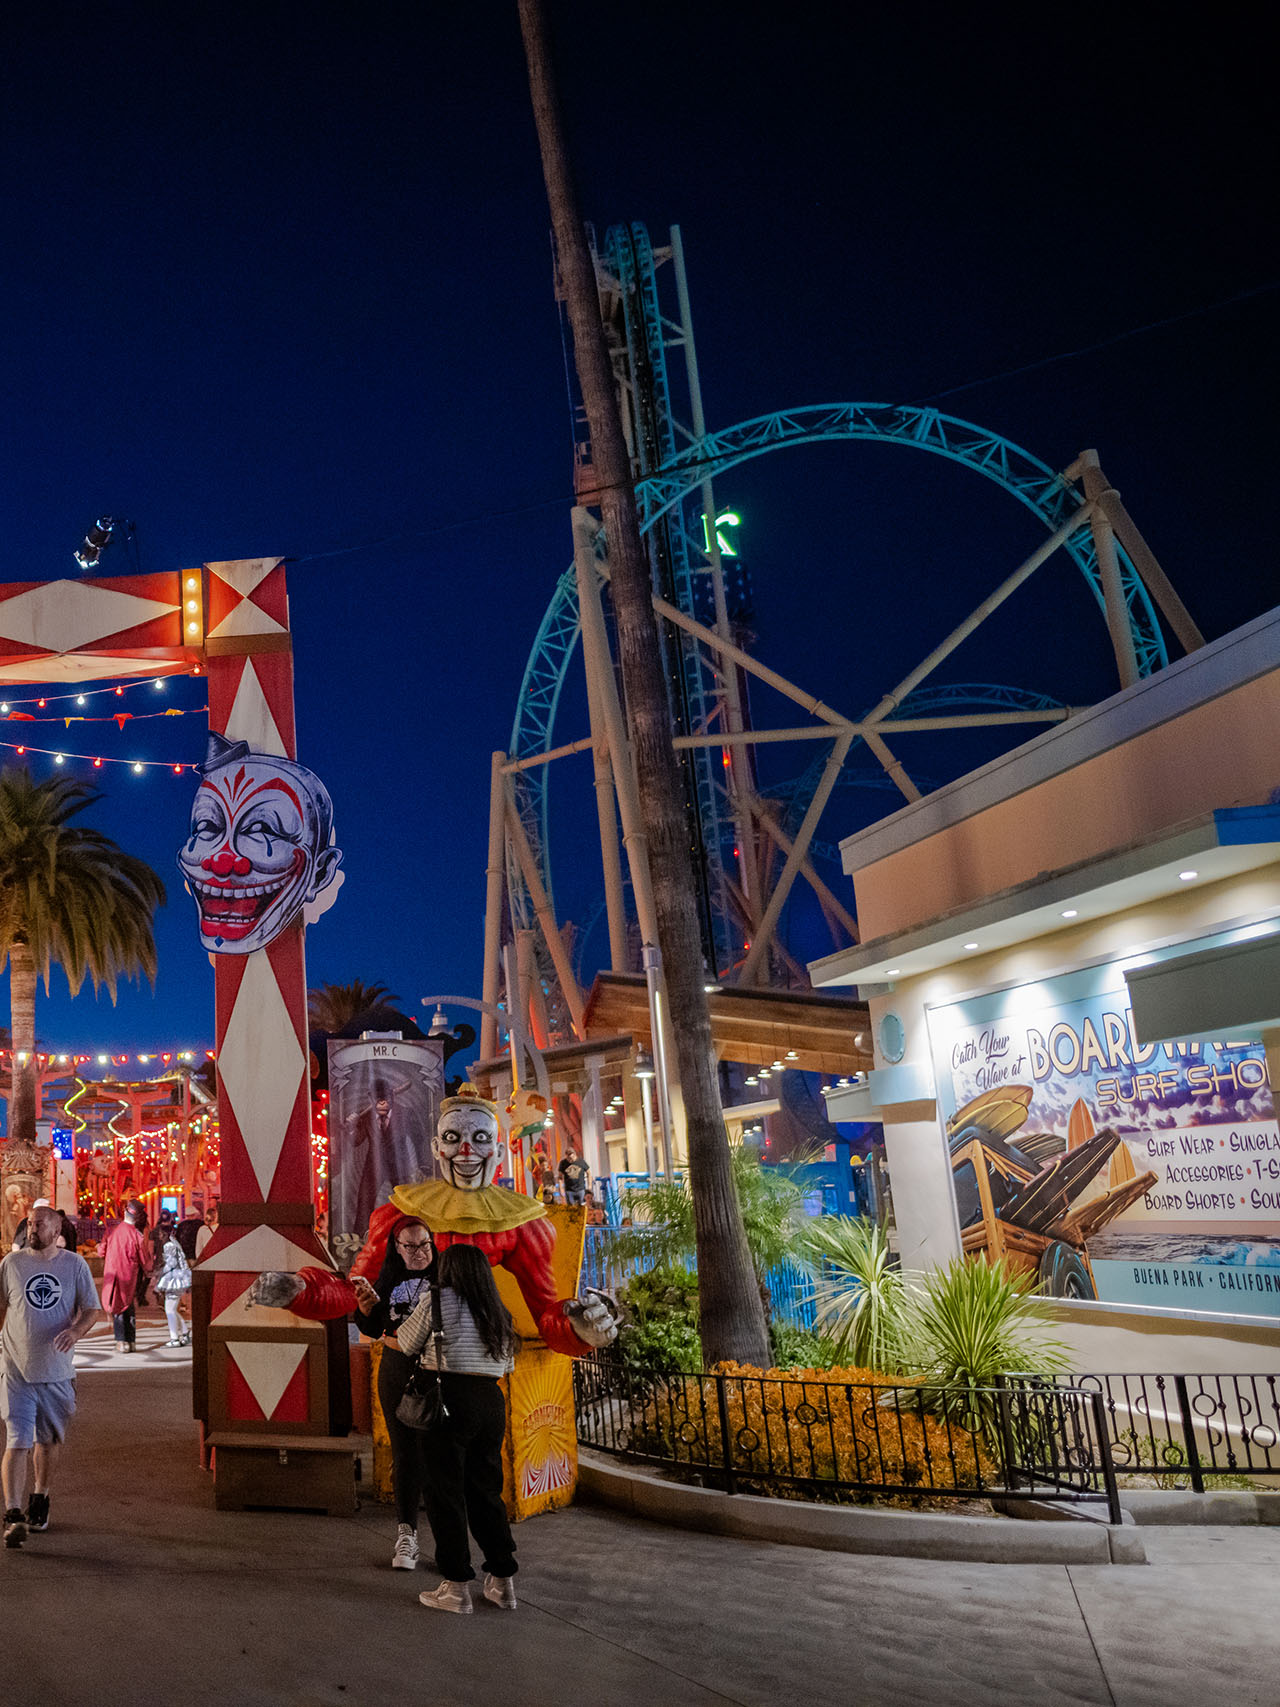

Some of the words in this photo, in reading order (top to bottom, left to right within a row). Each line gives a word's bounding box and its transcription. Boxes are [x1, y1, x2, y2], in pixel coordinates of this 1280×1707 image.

[373, 1046, 390, 1056] MR.
[392, 1046, 398, 1056] C
[952, 1039, 977, 1069] Catch
[979, 1029, 1010, 1063] Your
[976, 1062, 1008, 1090] Wave
[1012, 1054, 1026, 1075] at
[1096, 1069, 1178, 1107] SURF
[1187, 1056, 1271, 1096] SHO
[1147, 1138, 1175, 1157] SURF
[1179, 1134, 1215, 1155] WEAR
[1166, 1164, 1244, 1184] ACCESSORIES
[1143, 1191, 1182, 1210] BOARD
[1185, 1190, 1236, 1210] SHORTS
[1133, 1268, 1169, 1286] BUENA
[1173, 1269, 1204, 1288] PARK
